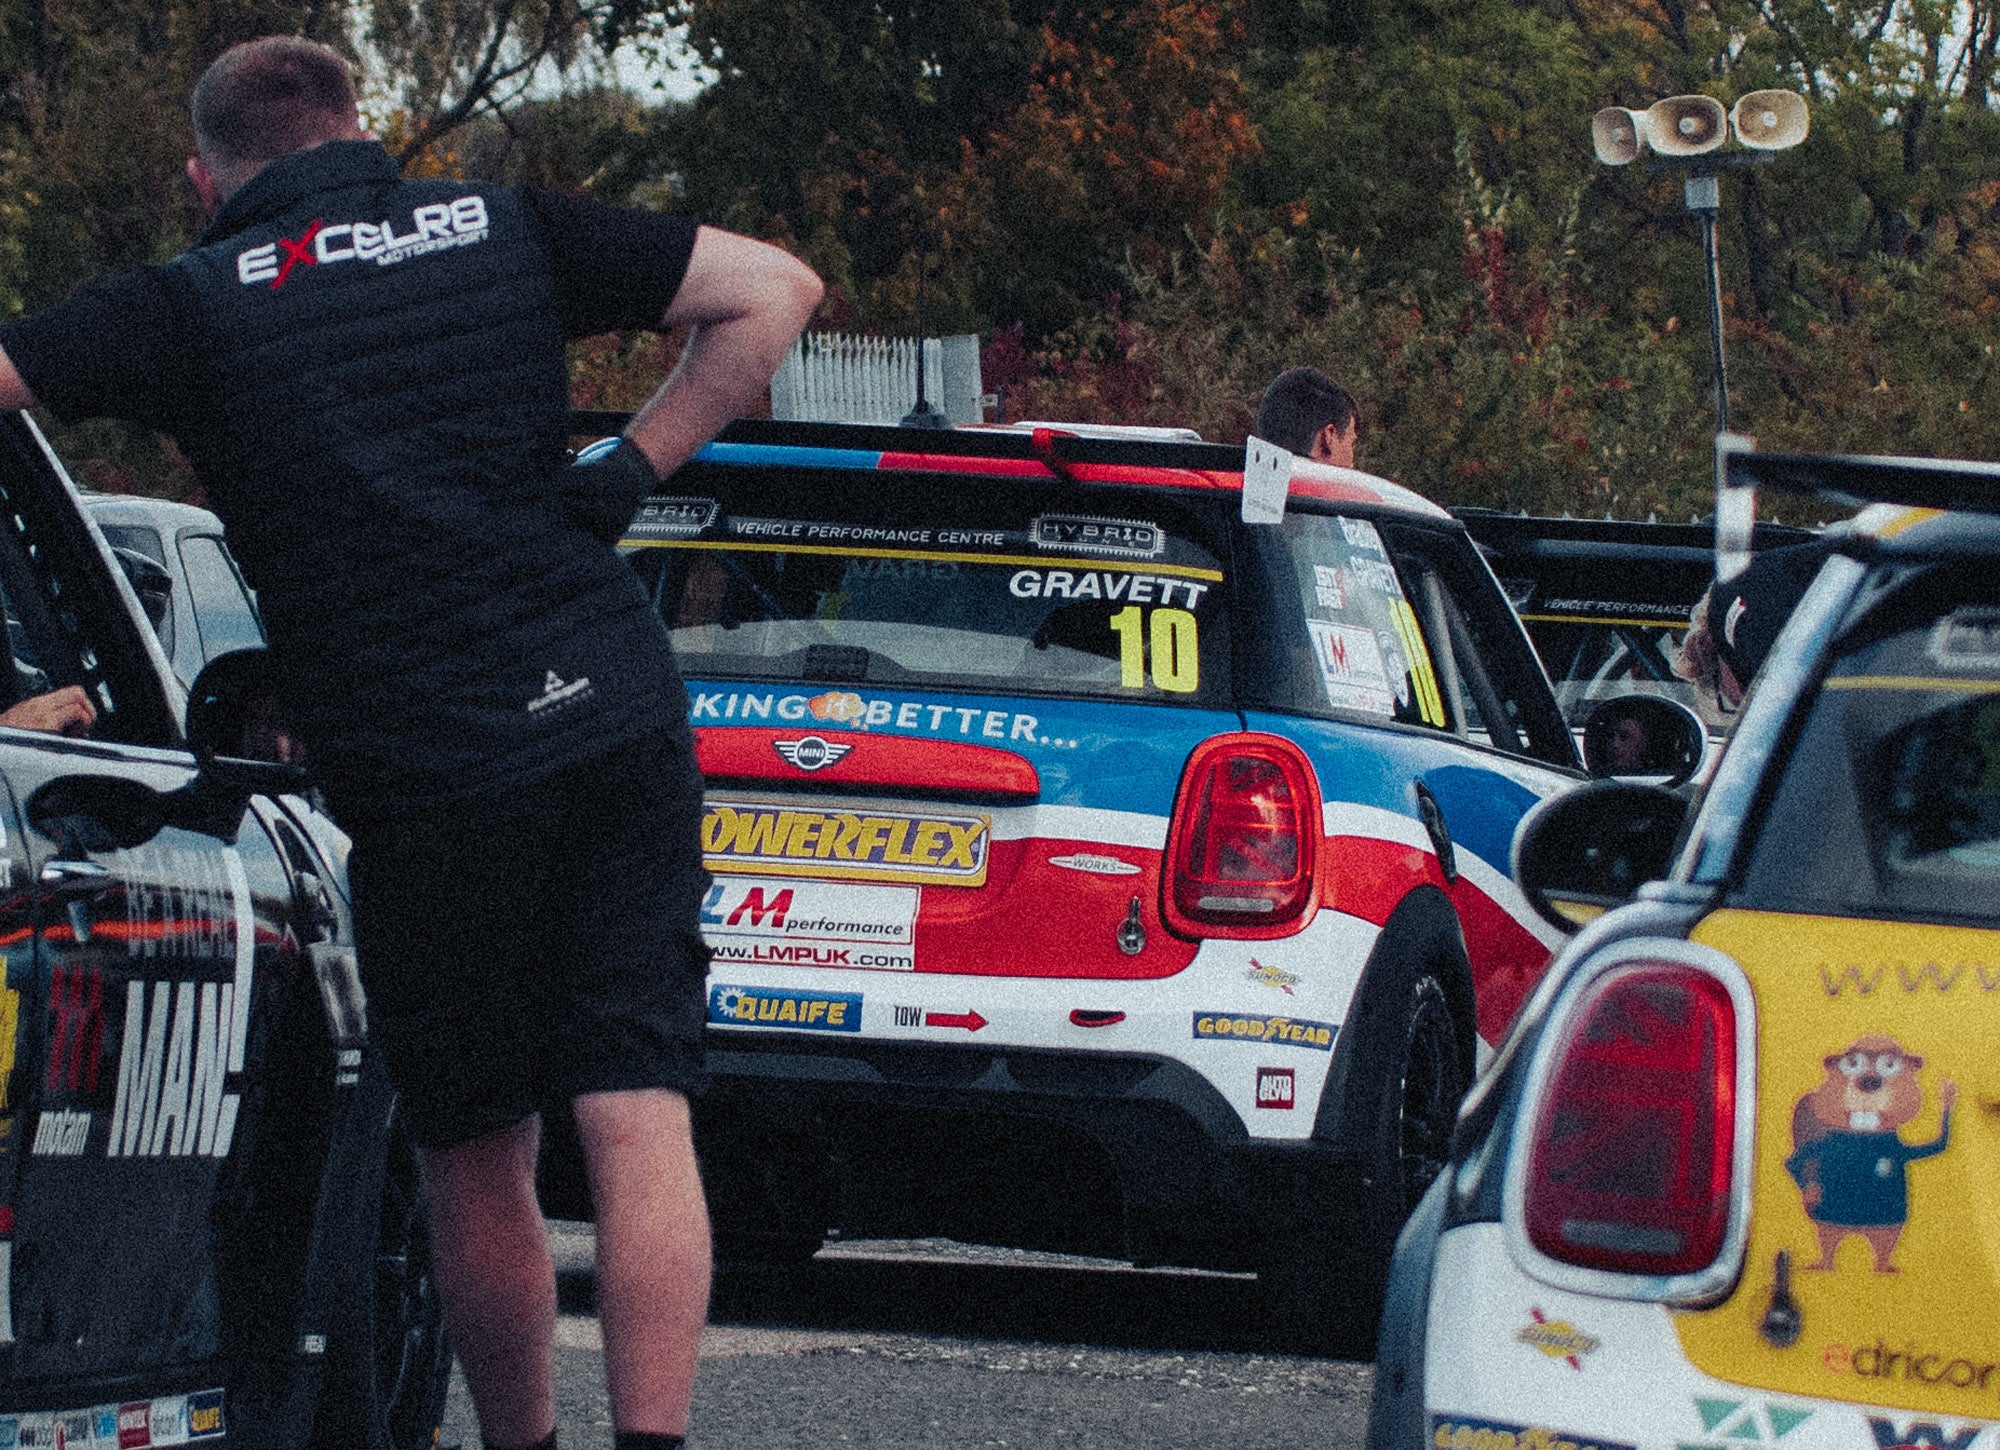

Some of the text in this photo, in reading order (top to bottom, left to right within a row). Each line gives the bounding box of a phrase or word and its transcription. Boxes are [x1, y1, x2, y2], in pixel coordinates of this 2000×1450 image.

[237, 195, 490, 289] EXCELR8
[735, 520, 1005, 545] VEHICLE PERFORMANCE CENTRE
[1042, 522, 1153, 542] HYBRID
[1009, 569, 1208, 610] GRAVETT
[1543, 598, 1691, 616] VEHICLE PERFORMANCE
[1109, 605, 1200, 694] 10
[864, 699, 1079, 749] BETTER...
[798, 747, 825, 758] MINI
[701, 807, 988, 868] OWERFLEX
[1073, 860, 1117, 872] WORKS
[786, 916, 904, 936] performance
[735, 996, 848, 1025] QUAIFE
[894, 1006, 922, 1028] TOW
[1197, 1016, 1331, 1046] GOODYEAR
